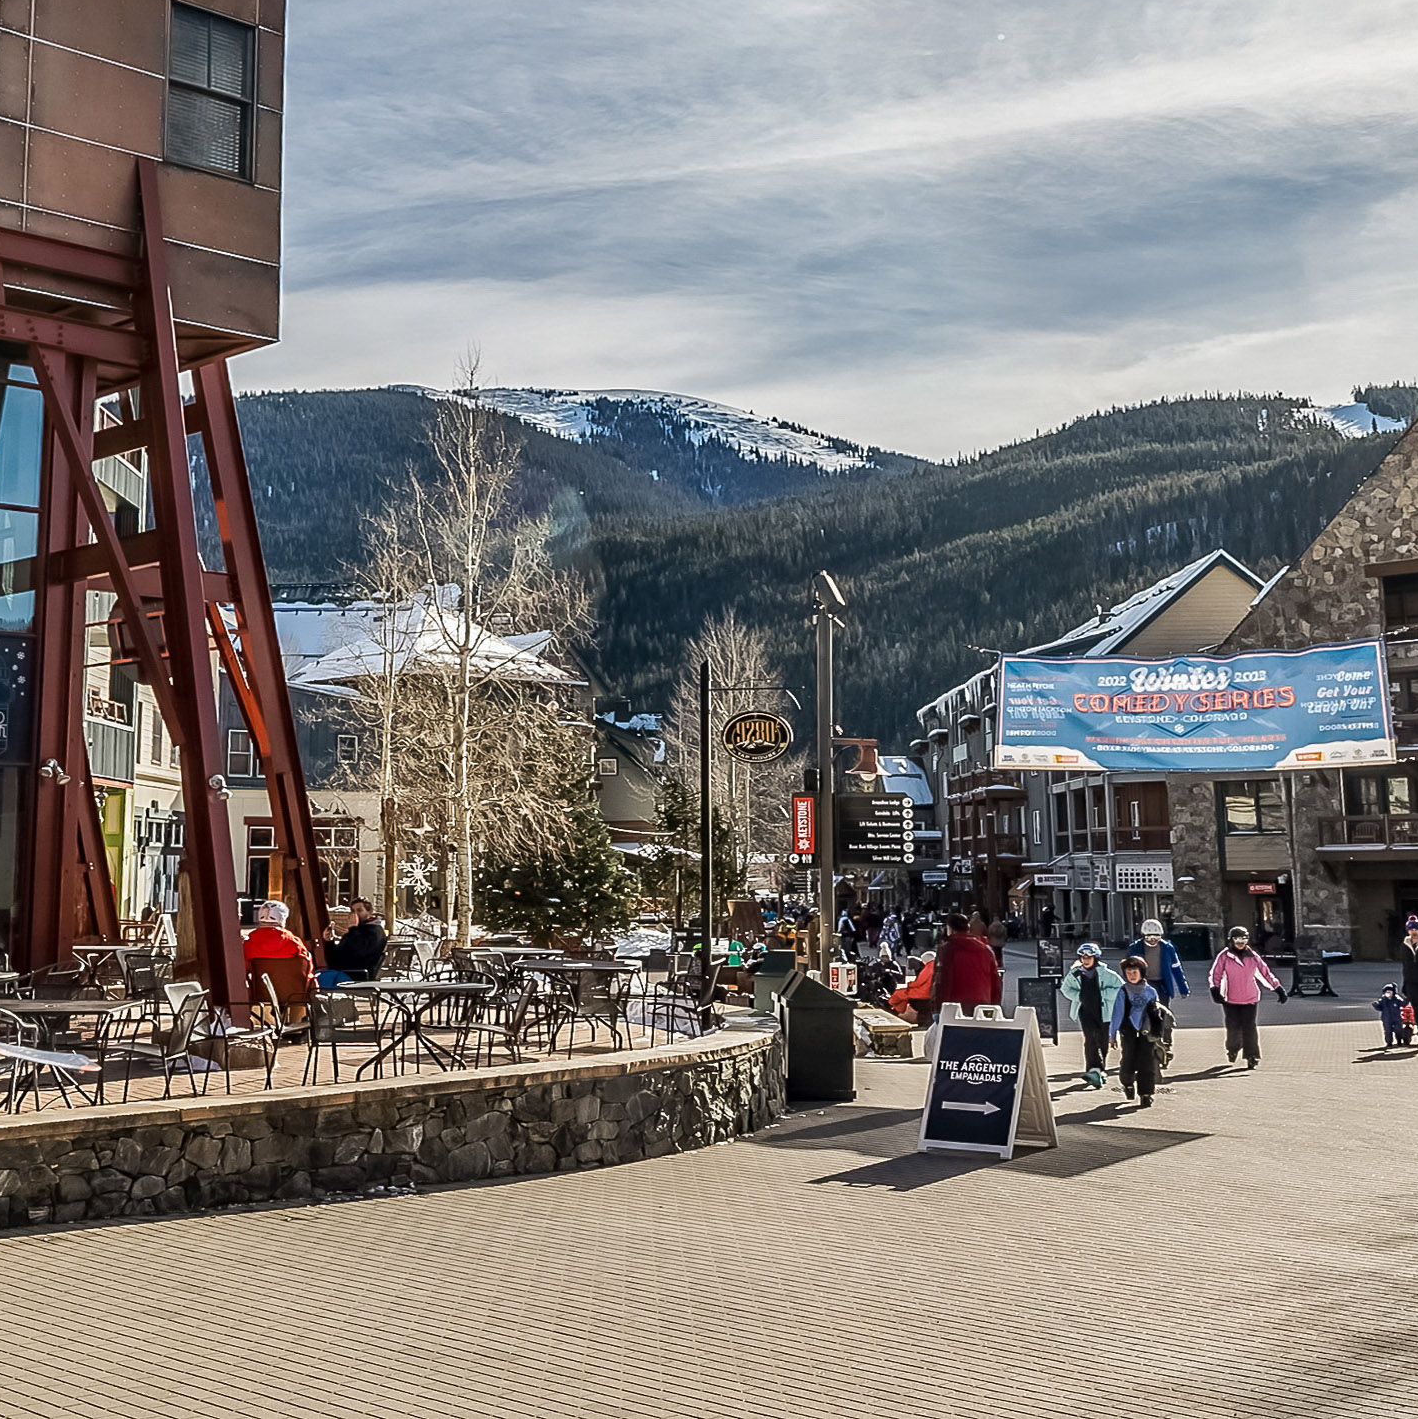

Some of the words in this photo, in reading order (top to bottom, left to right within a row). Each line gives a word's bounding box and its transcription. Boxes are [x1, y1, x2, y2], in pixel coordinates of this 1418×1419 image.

[1129, 667, 1231, 692] Winter
[1073, 693, 1190, 714] COMEDY
[1197, 686, 1296, 714] SERIES
[1317, 687, 1340, 699] Get
[1343, 685, 1373, 696] Your
[797, 800, 808, 838] KEYSTONE
[939, 1060, 960, 1071] THE
[960, 1062, 1017, 1074] ARGENTOS
[950, 1071, 1002, 1082] EMPANADAS
